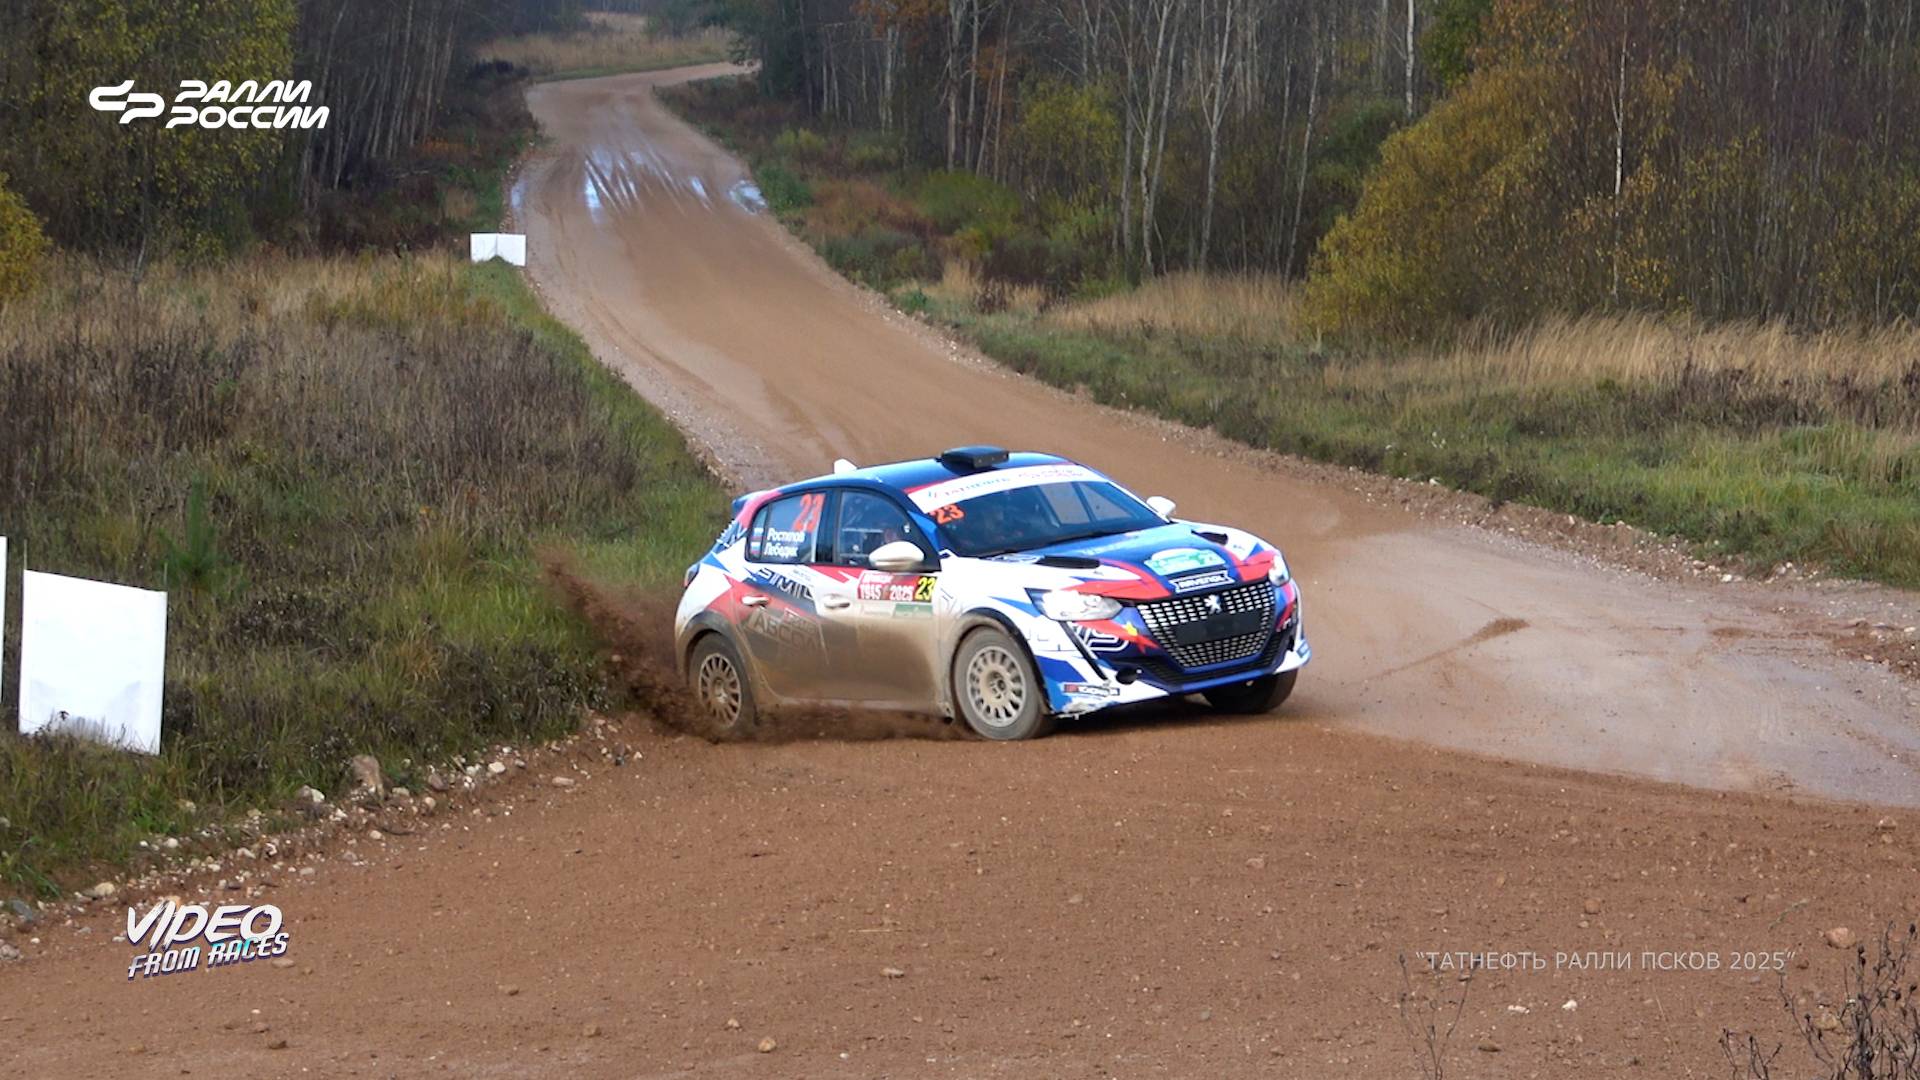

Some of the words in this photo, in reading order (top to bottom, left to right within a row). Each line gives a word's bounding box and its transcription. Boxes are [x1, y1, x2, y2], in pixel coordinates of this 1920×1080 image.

[792, 493, 826, 533] 23
[935, 503, 966, 525] 23
[859, 583, 882, 600] 1945
[889, 584, 915, 602] 2025
[914, 576, 936, 600] 23
